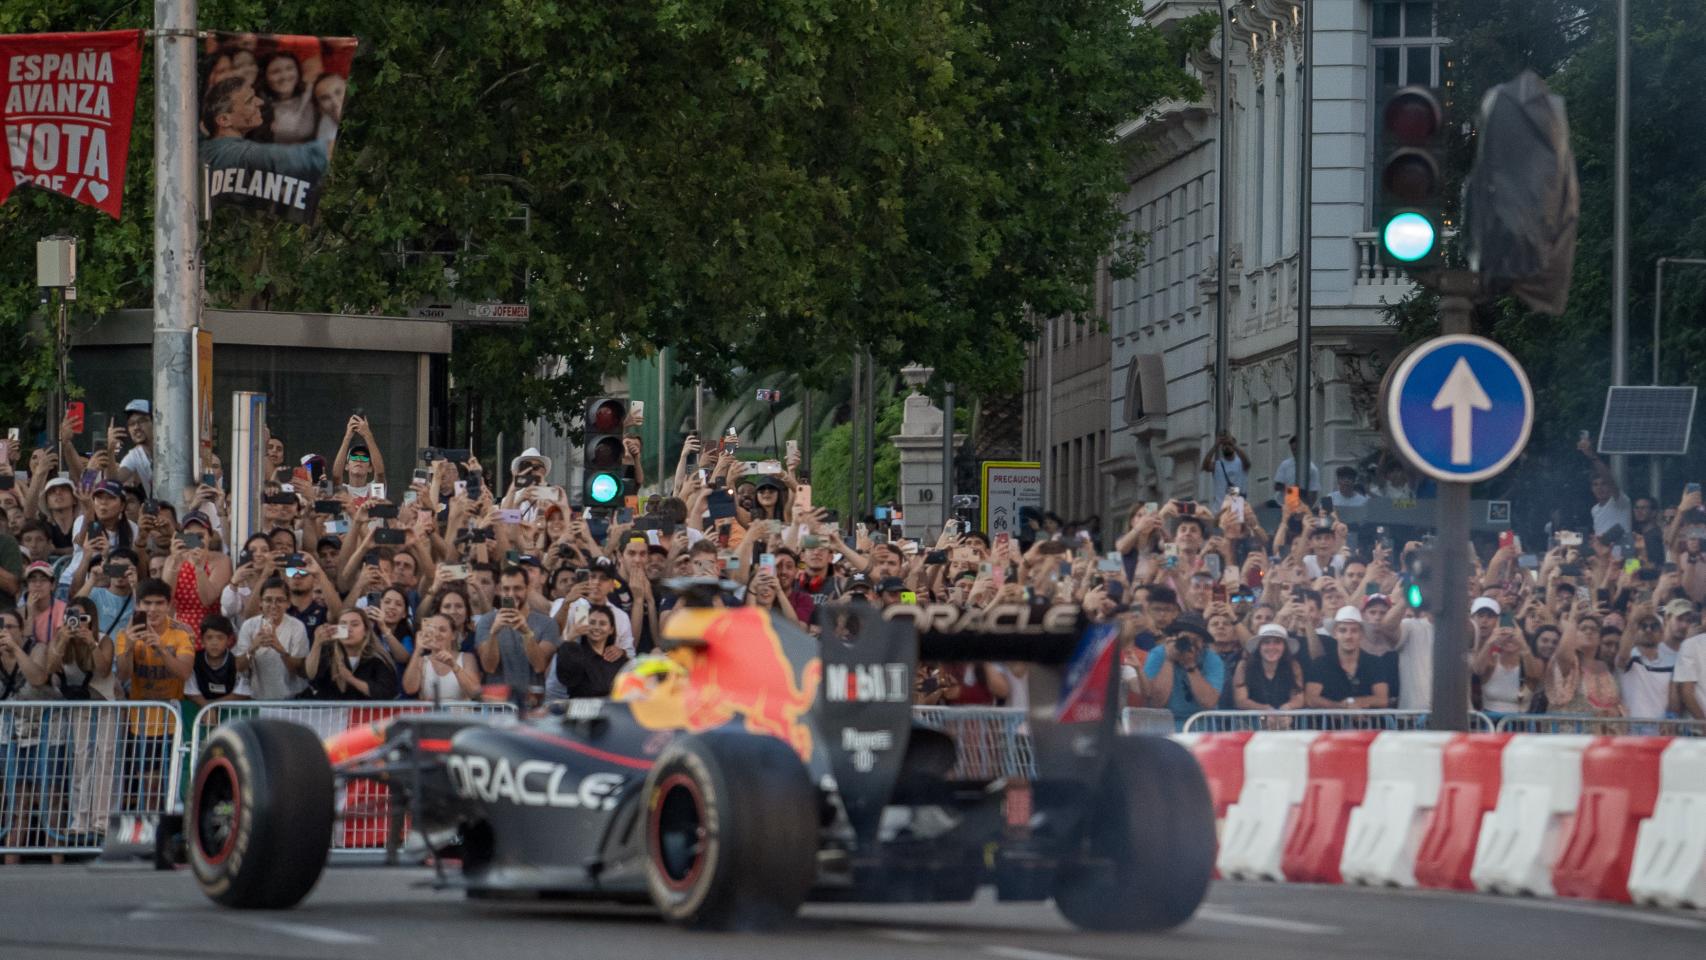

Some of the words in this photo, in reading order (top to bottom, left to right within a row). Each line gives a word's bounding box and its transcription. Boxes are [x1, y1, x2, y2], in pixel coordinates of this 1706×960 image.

[8, 48, 114, 84] ESPAÑA
[5, 83, 111, 118] AVANZA
[5, 123, 109, 181] VOTA
[492, 305, 528, 317] JOFEMESA
[918, 488, 934, 502] 10
[882, 603, 1081, 634] ORACLE
[447, 755, 624, 810] ORACLE
